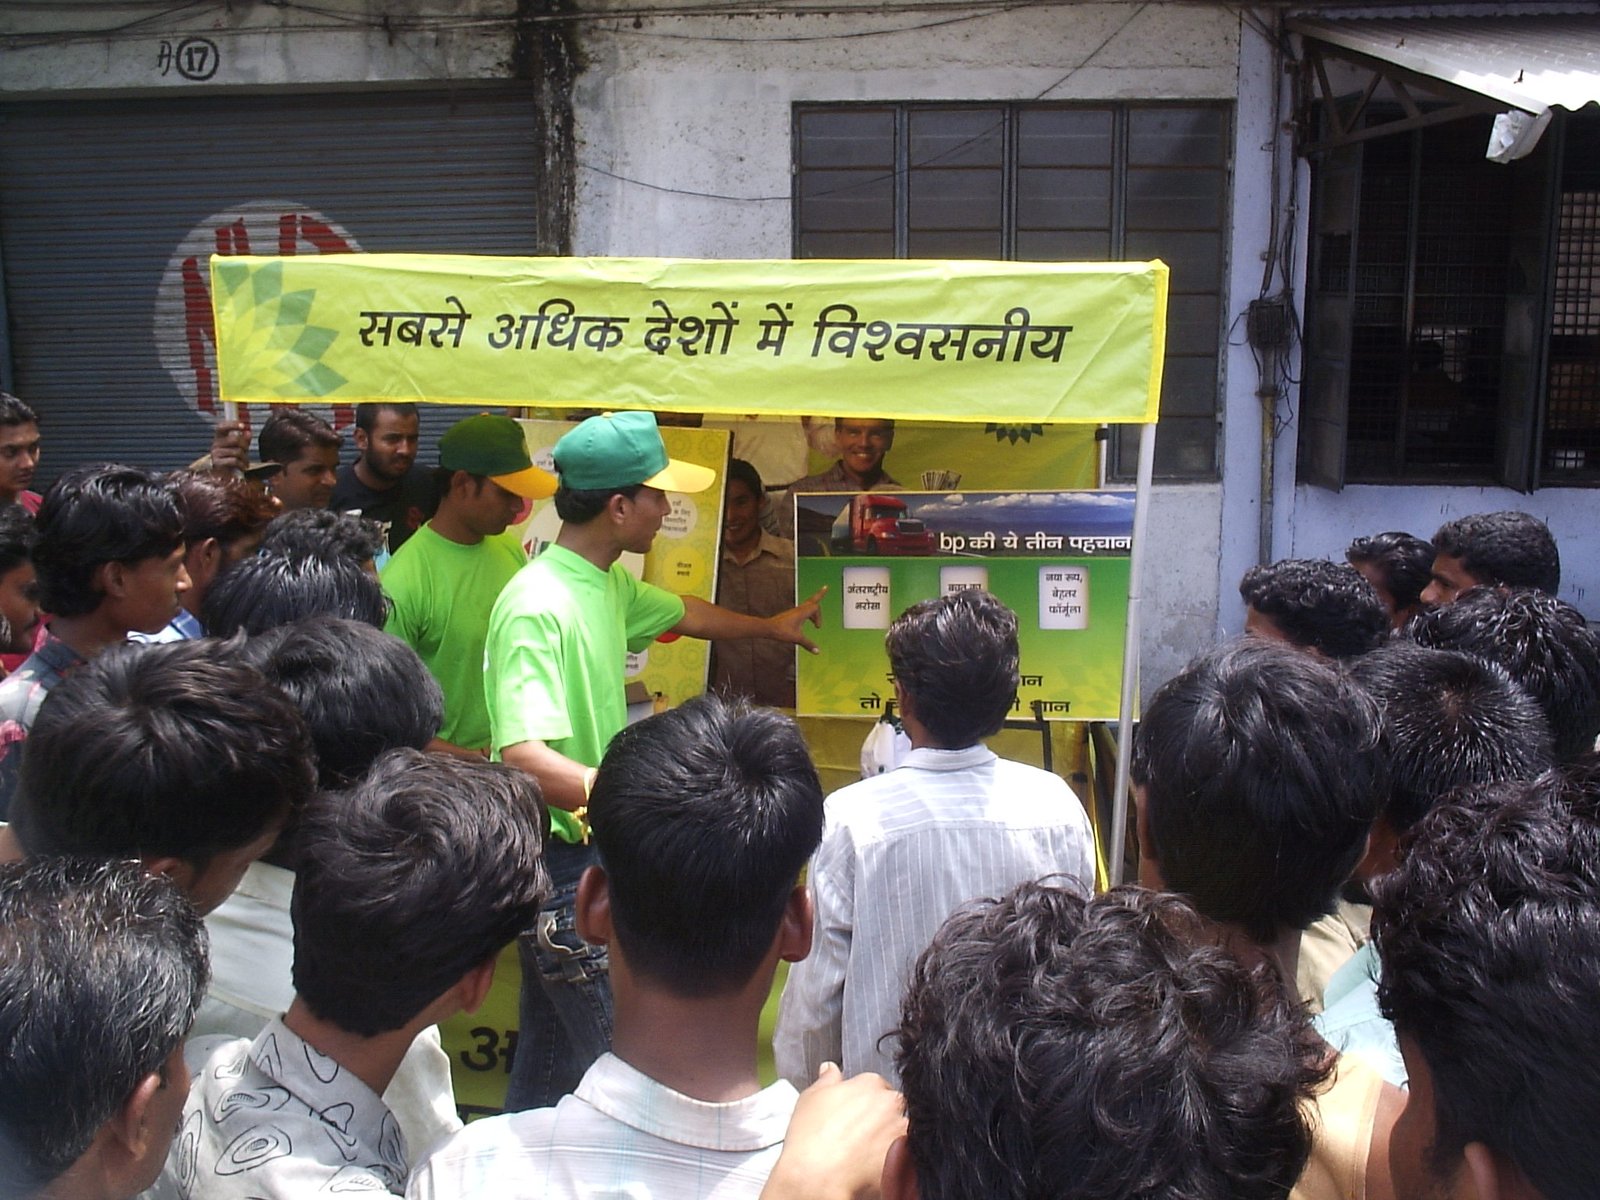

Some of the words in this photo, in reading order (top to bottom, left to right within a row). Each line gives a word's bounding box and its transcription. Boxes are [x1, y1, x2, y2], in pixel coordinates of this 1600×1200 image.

[185, 46, 209, 72] 17
[358, 295, 472, 349] सबसे
[488, 298, 630, 352] अधिक
[643, 299, 740, 357] देशों
[756, 302, 794, 357] में
[810, 303, 1074, 363] विश्वसनीय
[940, 532, 965, 554] bp
[969, 531, 996, 550] की
[1002, 530, 1019, 549] ये
[1025, 531, 1064, 550] तीन
[1069, 535, 1132, 553] पहचान
[860, 692, 881, 709] तो
